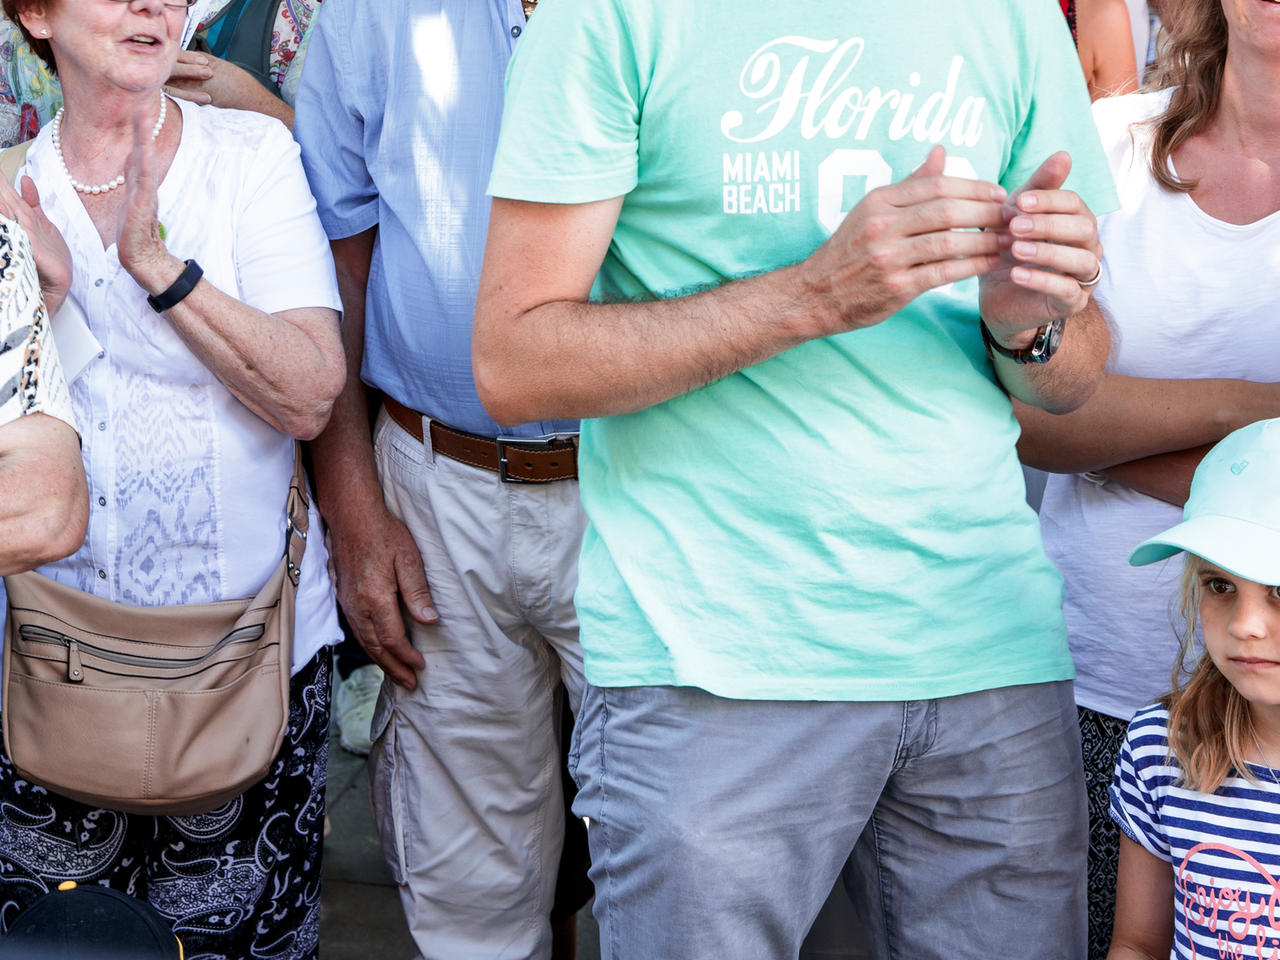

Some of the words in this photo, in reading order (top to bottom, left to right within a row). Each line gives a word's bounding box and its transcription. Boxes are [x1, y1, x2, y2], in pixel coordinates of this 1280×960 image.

[720, 35, 986, 147] Florida
[722, 150, 800, 183] MIAMI
[722, 180, 800, 214] BEACH
[1183, 873, 1266, 940] Enjoy
[1216, 932, 1244, 960] the
